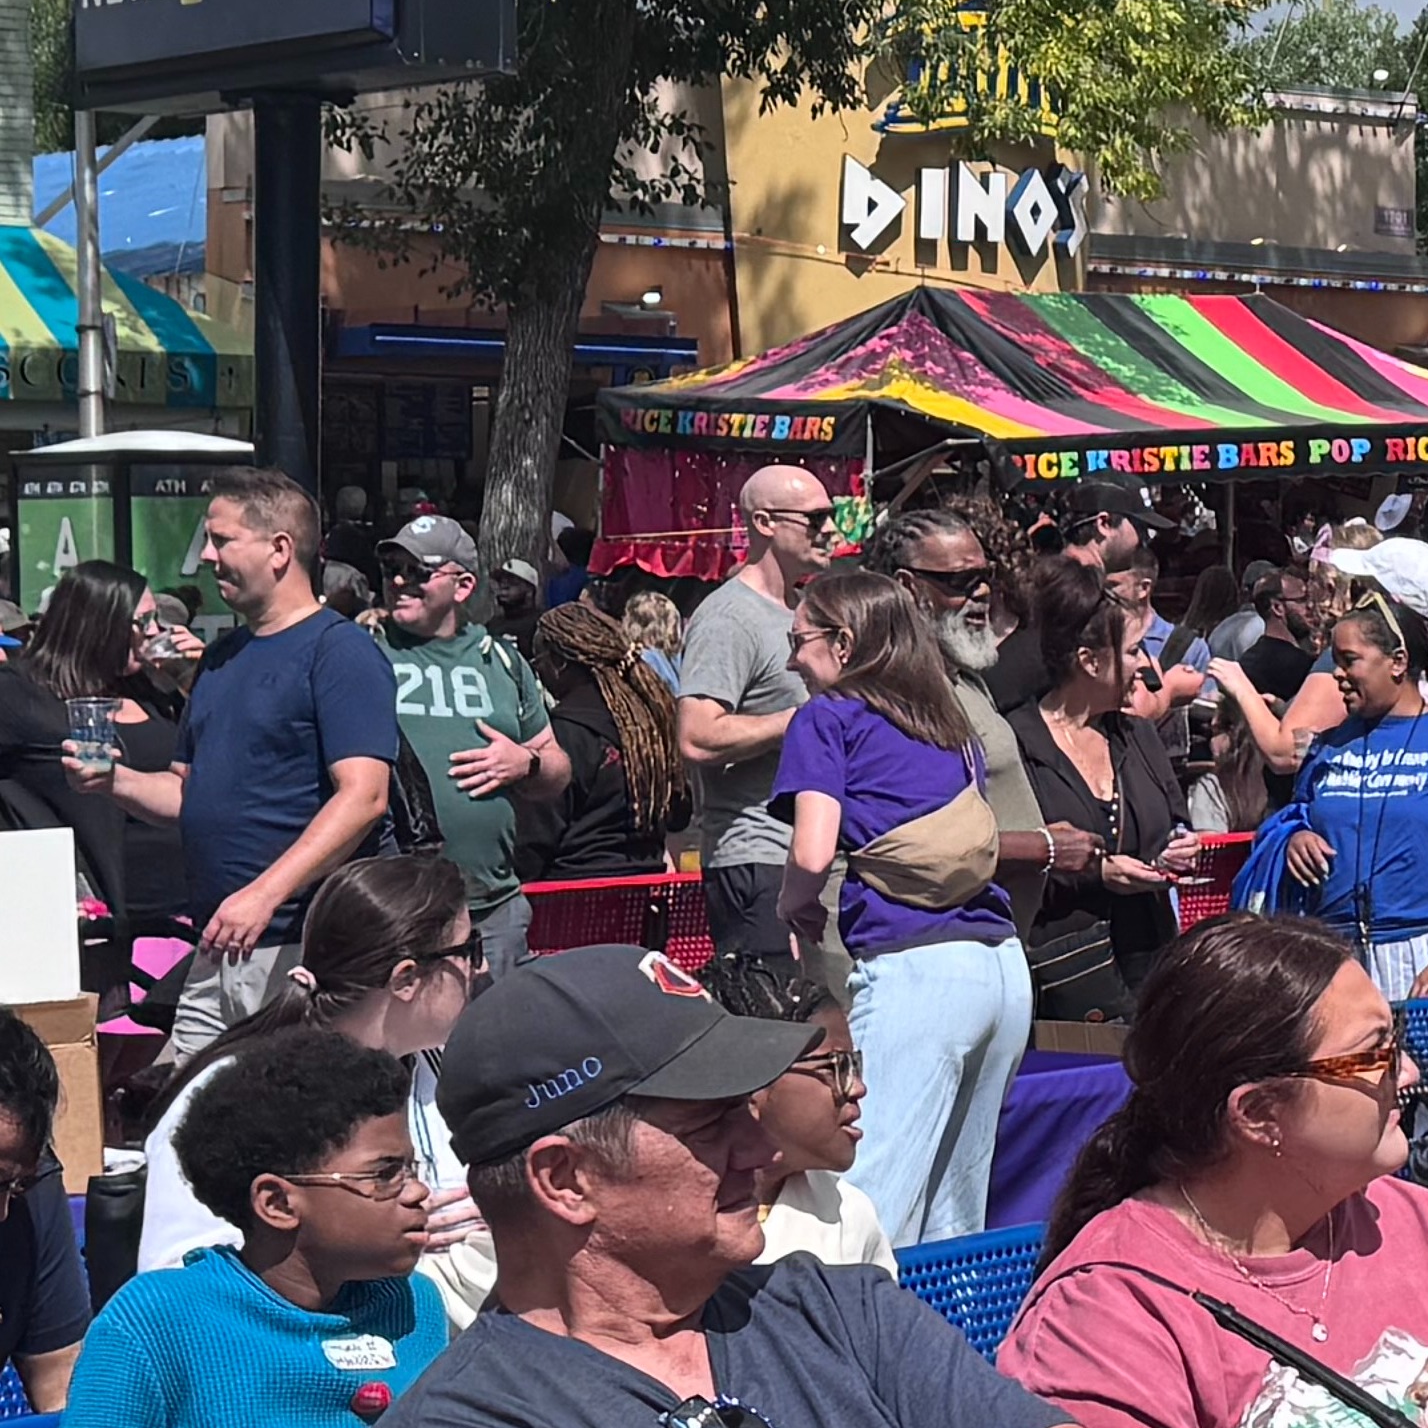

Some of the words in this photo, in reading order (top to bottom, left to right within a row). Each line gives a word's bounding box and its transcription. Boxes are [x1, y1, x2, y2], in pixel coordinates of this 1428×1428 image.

[621, 408, 673, 434] RICE
[676, 410, 770, 439] KRISTIE
[771, 414, 836, 442] BARS
[1086, 444, 1212, 473] KRISTIE
[1217, 440, 1296, 470] BARS
[1308, 438, 1371, 464] POP
[395, 662, 496, 718] 218
[525, 1056, 602, 1108] Juno
